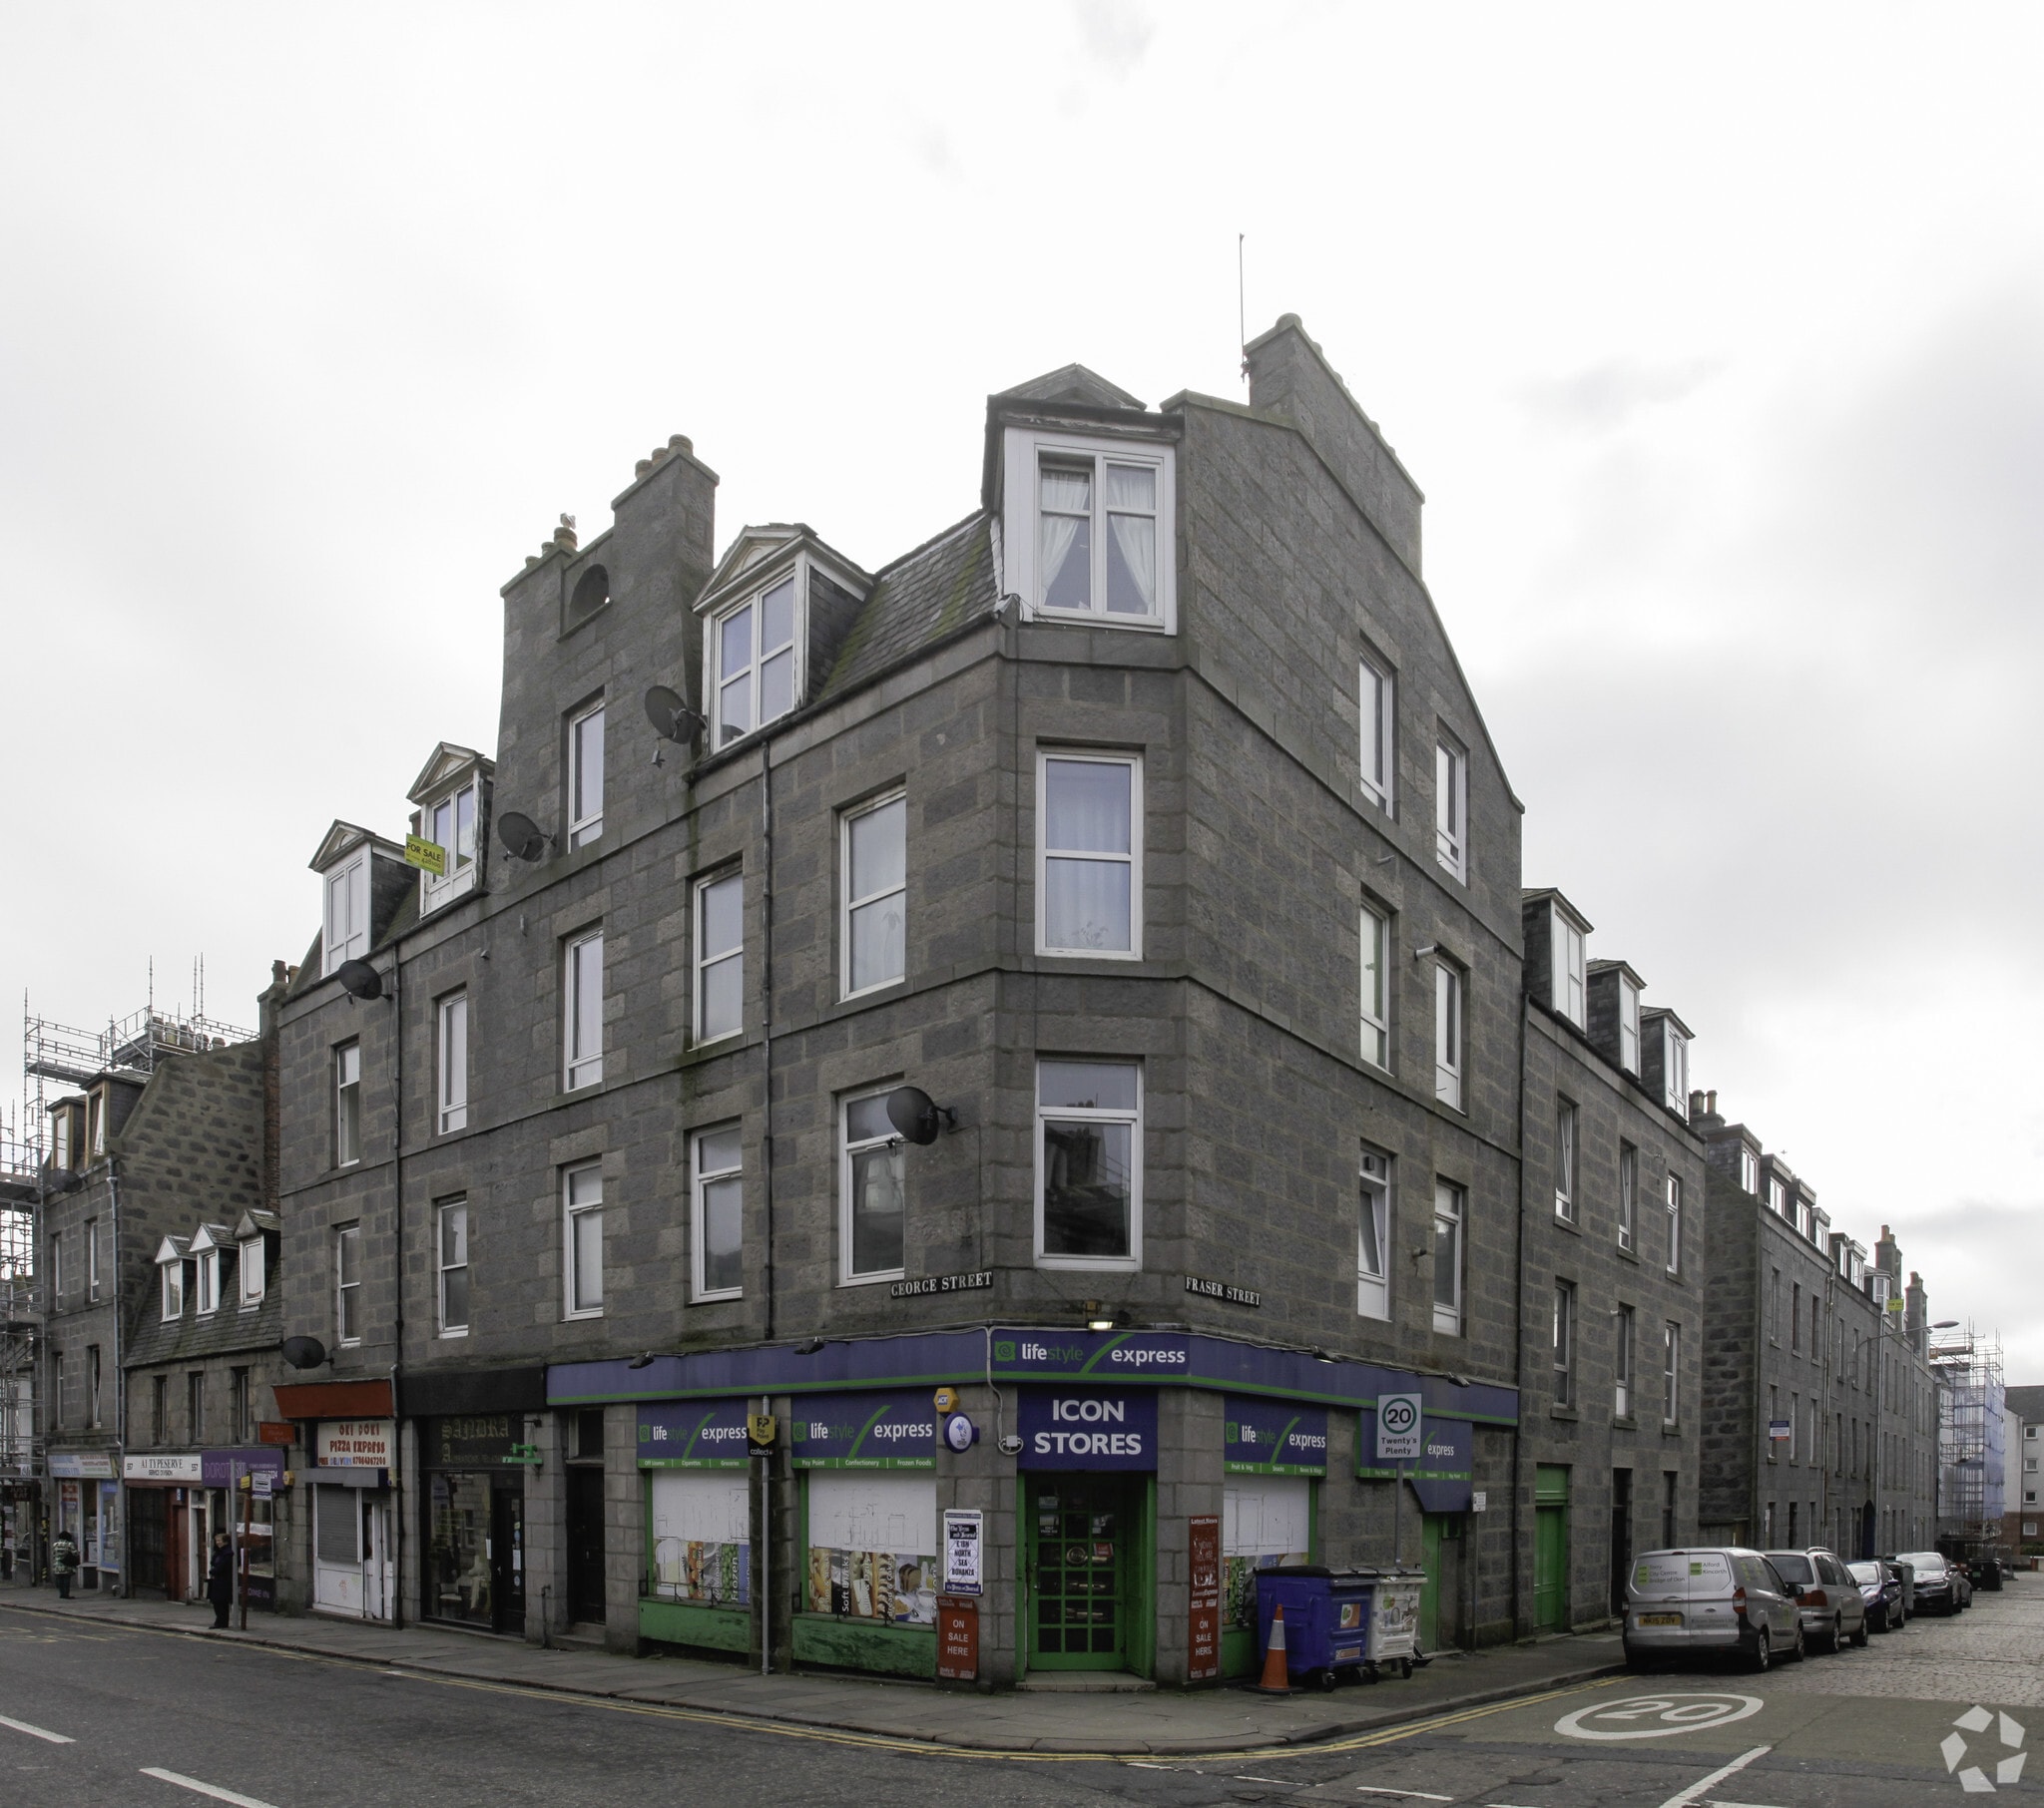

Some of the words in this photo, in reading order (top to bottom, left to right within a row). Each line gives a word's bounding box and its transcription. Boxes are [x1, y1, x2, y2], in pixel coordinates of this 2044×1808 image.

[406, 842, 421, 855] FOR
[423, 848, 441, 862] SALE
[941, 1271, 992, 1290] STREET
[1186, 1276, 1224, 1297] FRASER
[1227, 1286, 1261, 1306] STREET
[1022, 1343, 1083, 1364] lifestyle
[1111, 1349, 1186, 1366] express
[1053, 1400, 1124, 1422] ICON
[1387, 1408, 1411, 1424] 20
[654, 1425, 687, 1442] lifestyle
[702, 1427, 747, 1443] express
[810, 1422, 854, 1441] lifestyle
[873, 1423, 932, 1442] express
[1242, 1424, 1276, 1447] lifestyle
[1289, 1433, 1325, 1451] express
[330, 1440, 350, 1453] PIZZA
[353, 1441, 385, 1454] EXPRESS
[1035, 1433, 1141, 1455] STORES
[1427, 1444, 1454, 1458] express
[149, 1459, 184, 1469] TYPESERVE
[845, 1459, 879, 1468] Confectionery
[862, 1558, 871, 1582] Dairy
[951, 1568, 975, 1577] BONANZA
[952, 1619, 965, 1628] ON
[1199, 1619, 1209, 1629] ON
[948, 1631, 969, 1642] SALE
[1196, 1633, 1212, 1642] SALE
[947, 1645, 969, 1656] HERE
[1195, 1646, 1212, 1656] HERE
[1595, 1701, 1733, 1722] 20
